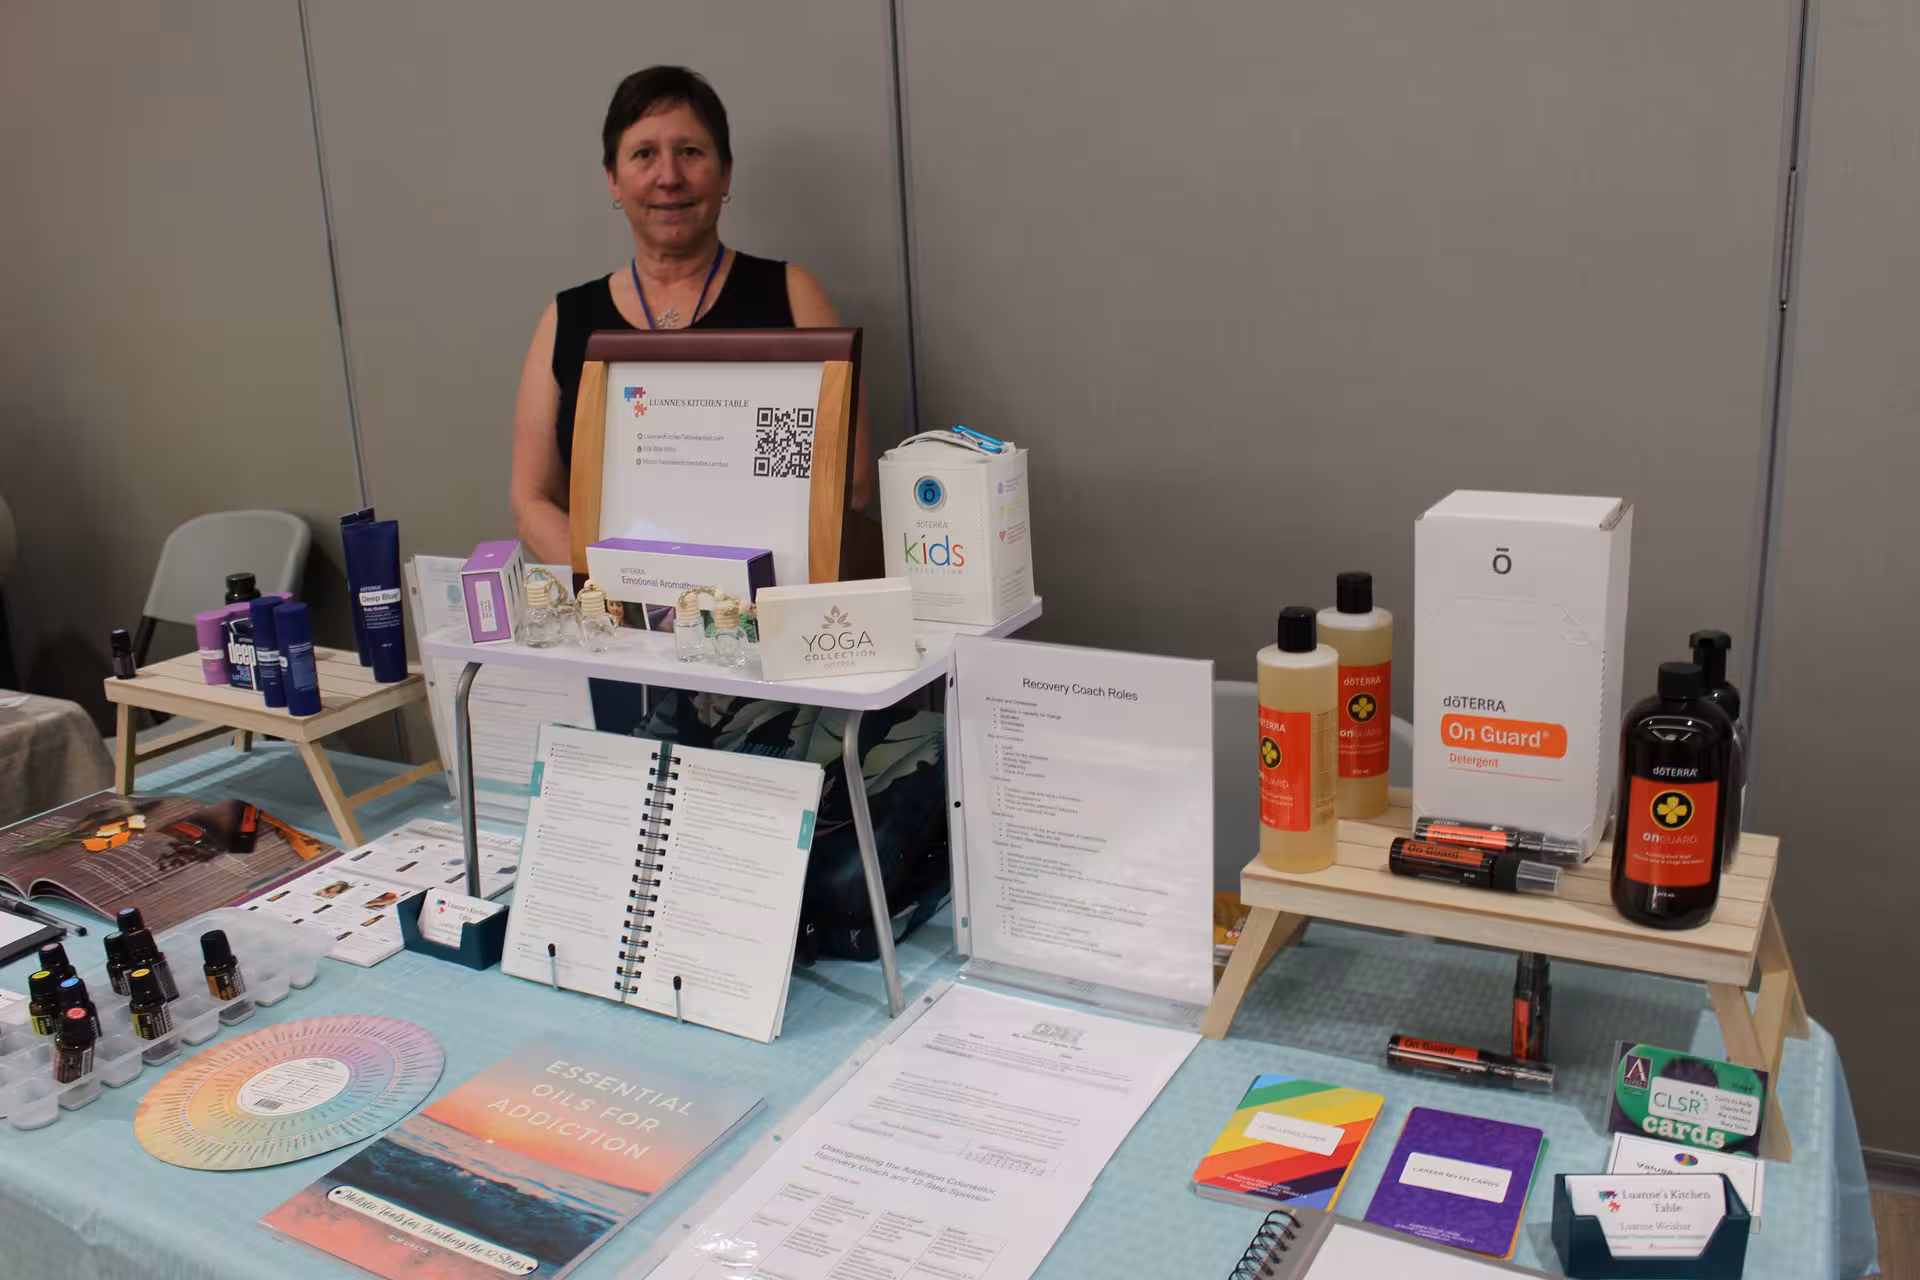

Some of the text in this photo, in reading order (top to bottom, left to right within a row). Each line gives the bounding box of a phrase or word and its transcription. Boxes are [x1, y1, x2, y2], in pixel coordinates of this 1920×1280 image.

[649, 399, 686, 407] LUANNE'S
[687, 399, 721, 407] KITCHEN
[904, 532, 965, 568] kids
[621, 576, 658, 587] Emotional
[801, 630, 875, 653] YOGA
[804, 650, 876, 662] COLLECTION
[1022, 677, 1138, 701] Recovery Coach Roles
[1448, 722, 1475, 741] On
[1449, 752, 1499, 769] Detergent
[1407, 843, 1423, 853] On
[545, 1059, 693, 1116] ESSENTIAL
[531, 1084, 661, 1134] OILS FOR
[1653, 1091, 1702, 1116] CLSR
[487, 1098, 650, 1160] ADDICTION
[1642, 1116, 1726, 1149] cards
[814, 1151, 857, 1170] Recovery
[858, 1164, 889, 1178] Coach
[889, 1173, 909, 1184] and
[910, 1177, 947, 1194] 12-Step
[821, 1143, 997, 1196] Distinguishing the Addiction Counselor
[1412, 1167, 1444, 1177] CAREER
[1471, 1177, 1500, 1188] CARDS
[1622, 1189, 1711, 1201] Luanne's Kitchen
[1653, 1203, 1682, 1214] Table
[339, 1190, 377, 1211] Holistic
[378, 1205, 407, 1223] Tools
[400, 1216, 420, 1231] for
[422, 1223, 470, 1252] Working
[464, 1239, 483, 1254] the
[484, 1246, 495, 1259] 12
[494, 1253, 527, 1271] Steps
